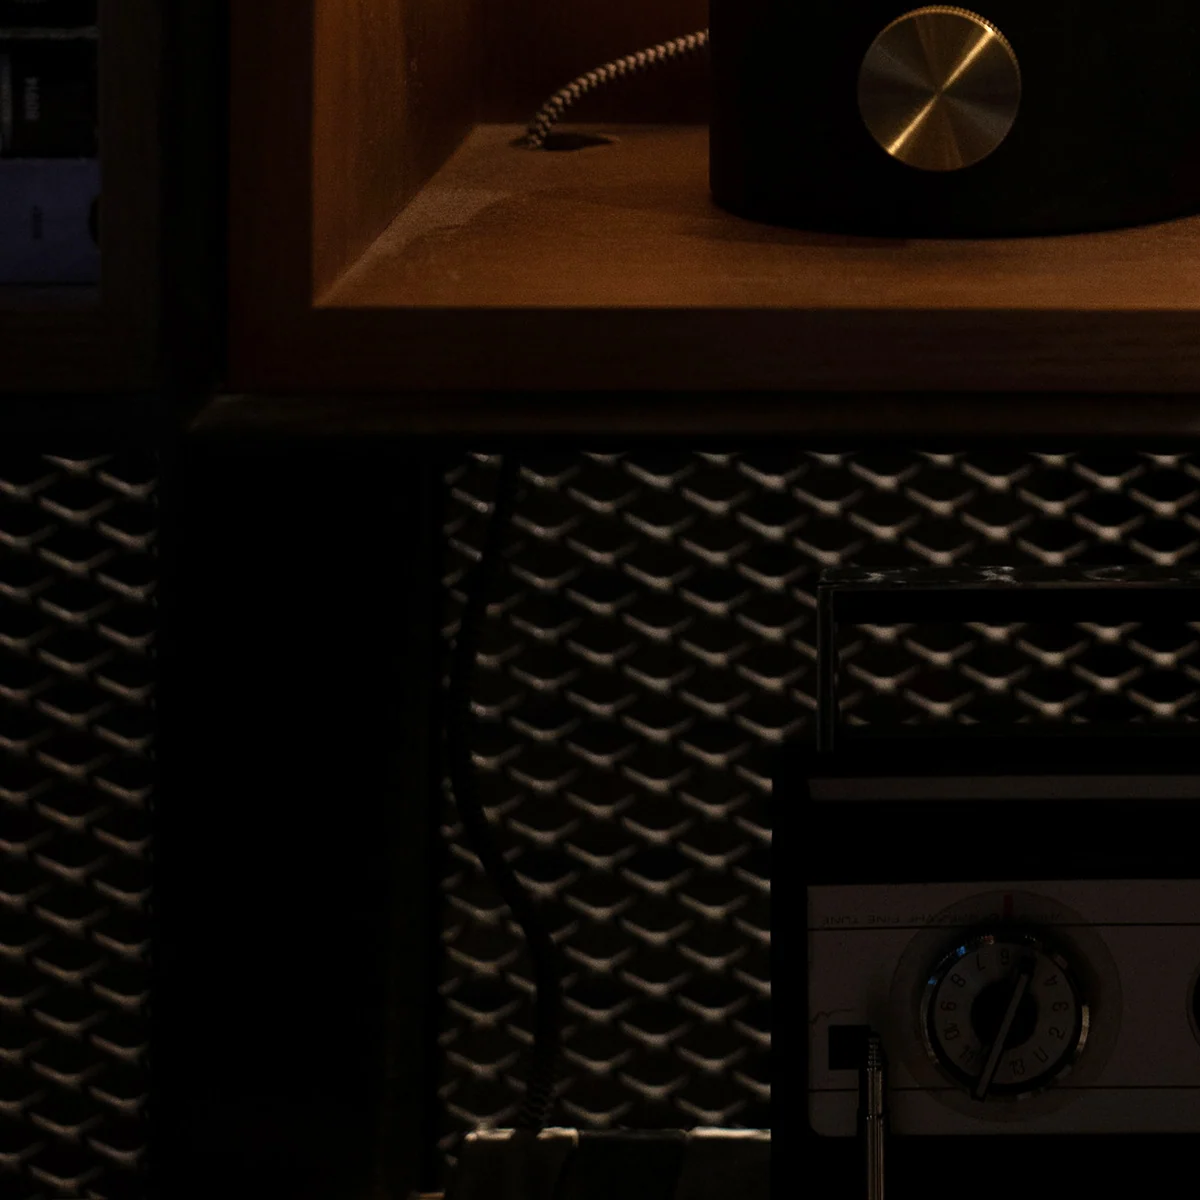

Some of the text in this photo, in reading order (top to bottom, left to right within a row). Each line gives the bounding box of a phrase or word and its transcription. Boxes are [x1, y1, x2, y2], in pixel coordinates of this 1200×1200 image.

[974, 953, 986, 972] 7
[949, 972, 967, 989] 8
[1043, 973, 1059, 989] 4
[1052, 1000, 1069, 1014] 3
[1048, 1025, 1066, 1040] 2
